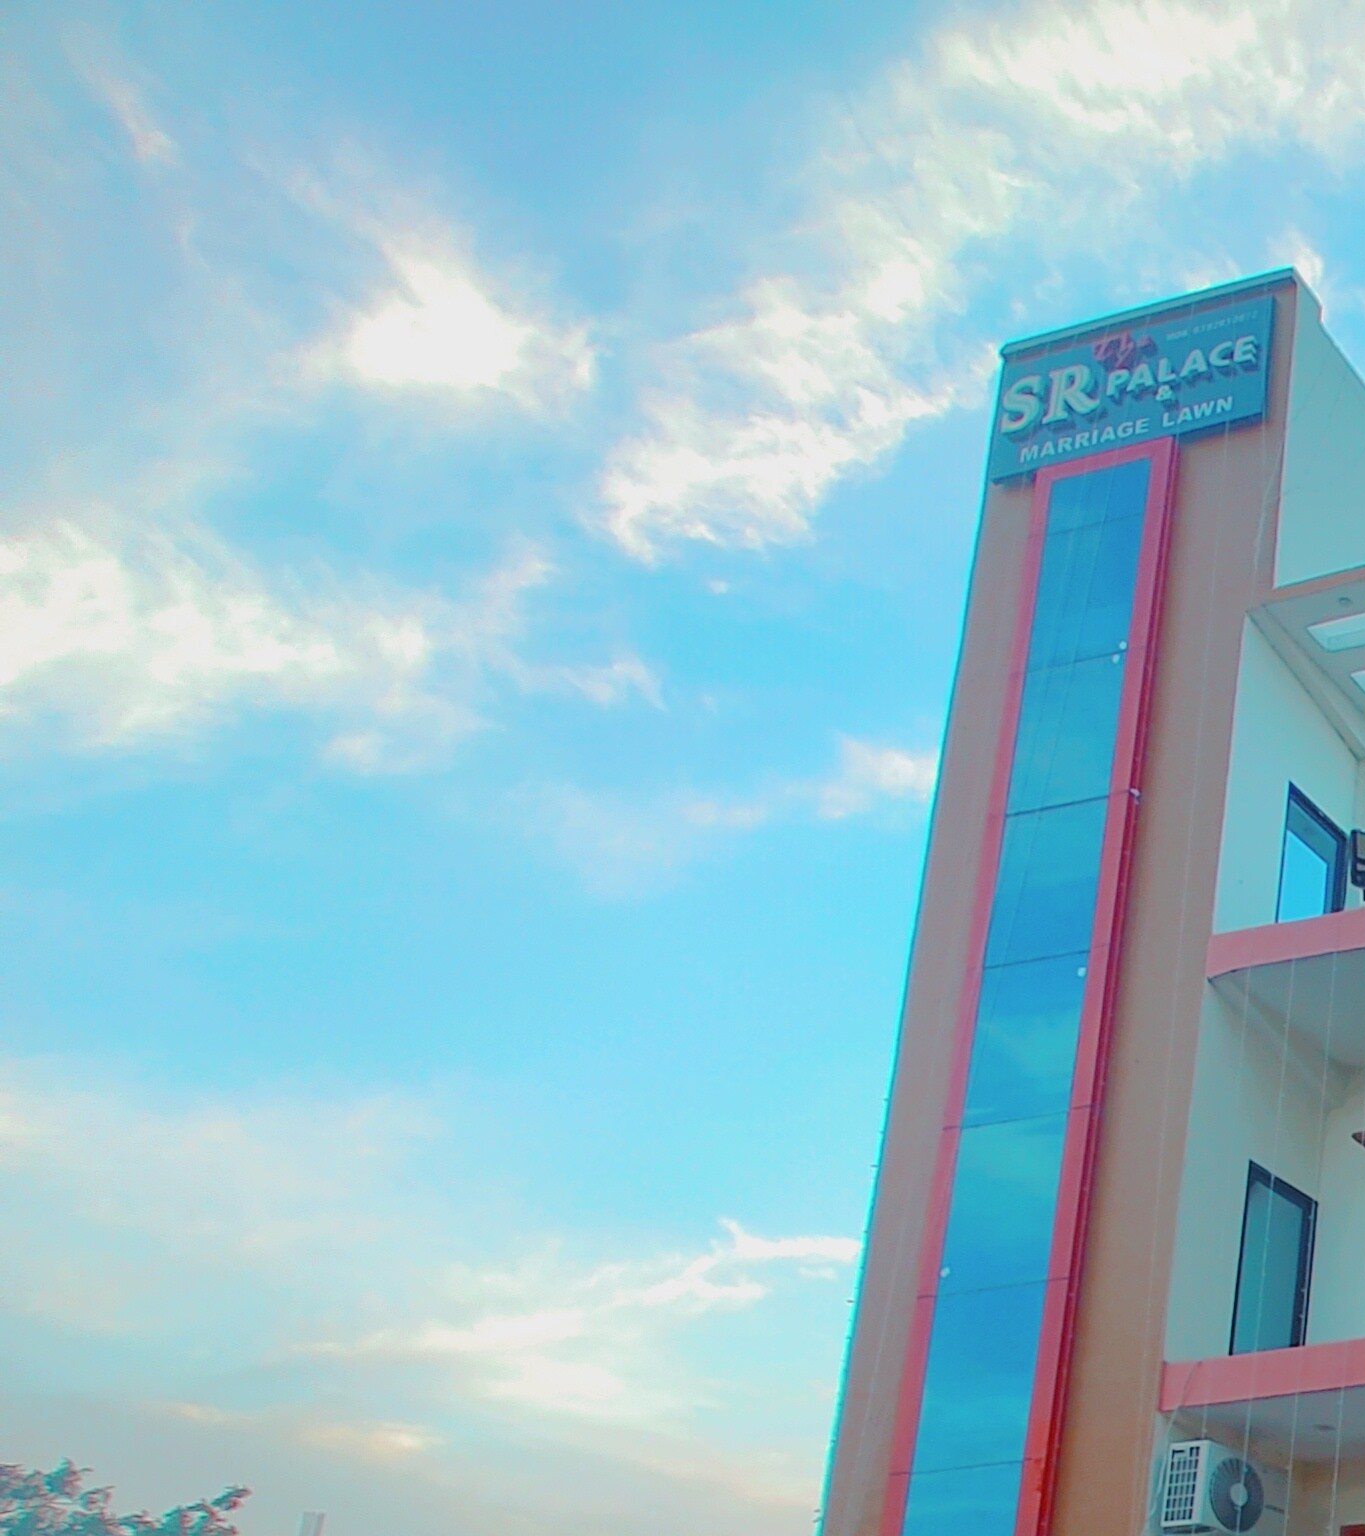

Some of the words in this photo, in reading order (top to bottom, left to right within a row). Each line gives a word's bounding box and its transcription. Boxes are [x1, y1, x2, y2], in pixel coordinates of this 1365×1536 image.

[1001, 364, 1100, 433] SR
[1106, 335, 1257, 397] PALACE
[1155, 385, 1173, 402] &
[1019, 417, 1150, 463] MARRIAGE
[1162, 396, 1233, 427] LAWN
